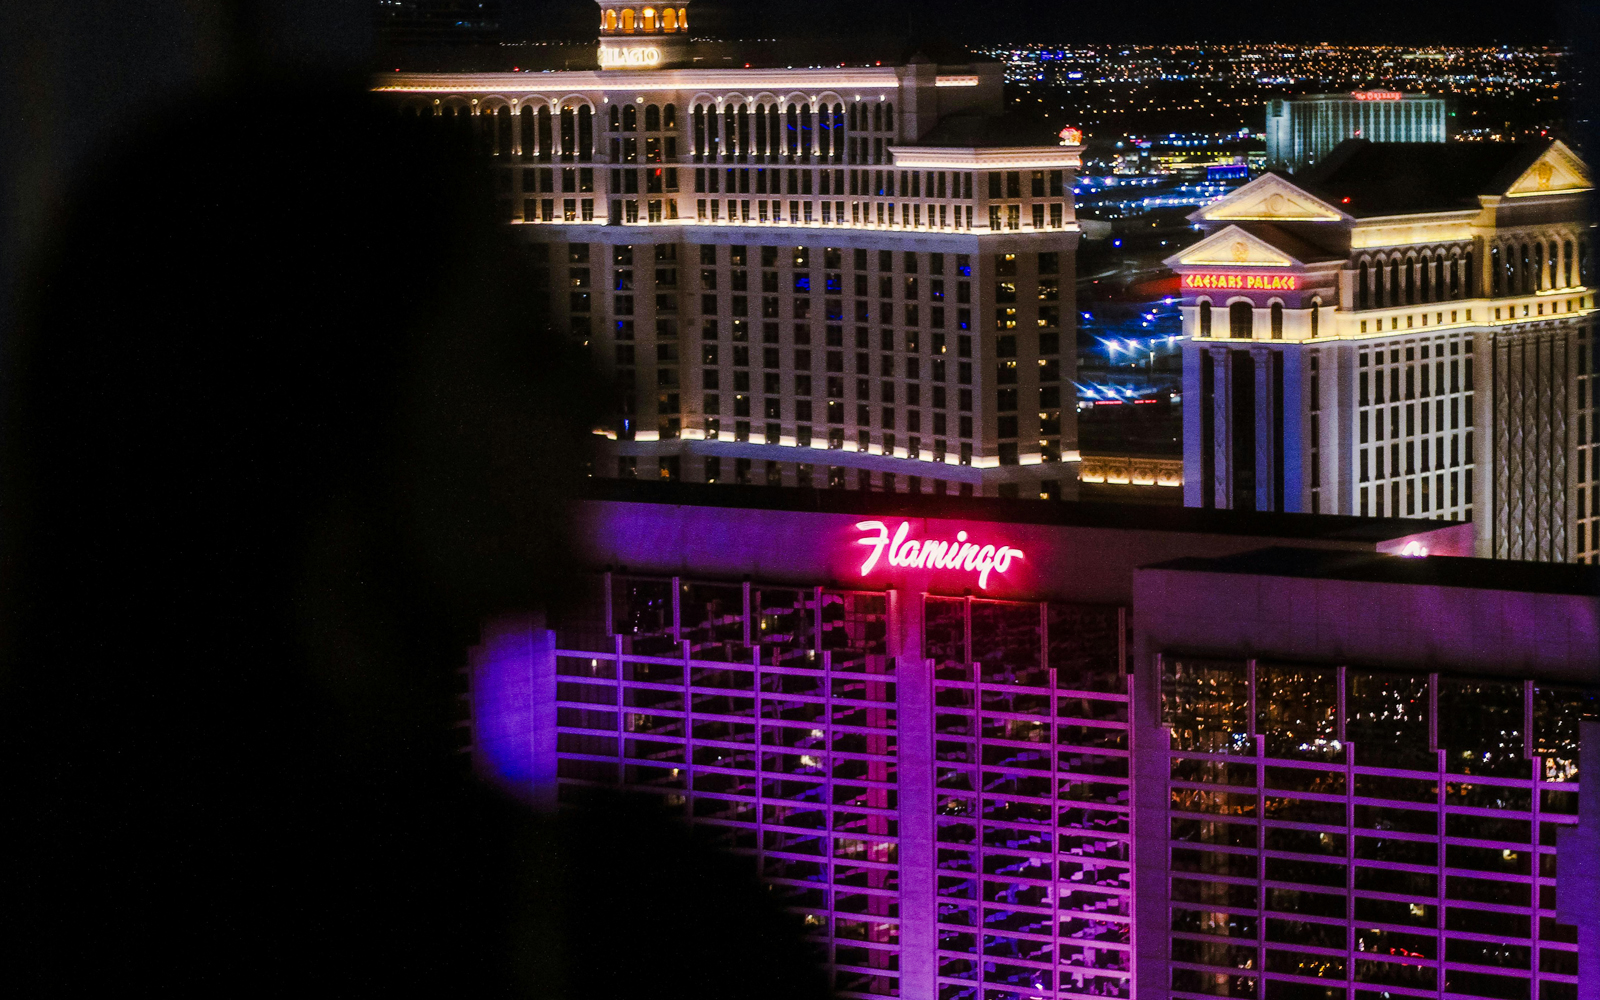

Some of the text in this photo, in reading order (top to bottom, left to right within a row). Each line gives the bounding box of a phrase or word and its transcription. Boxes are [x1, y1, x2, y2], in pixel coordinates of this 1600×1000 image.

[1185, 274, 1295, 290] CAESARS PALACE
[855, 520, 1024, 590] Flamingo
